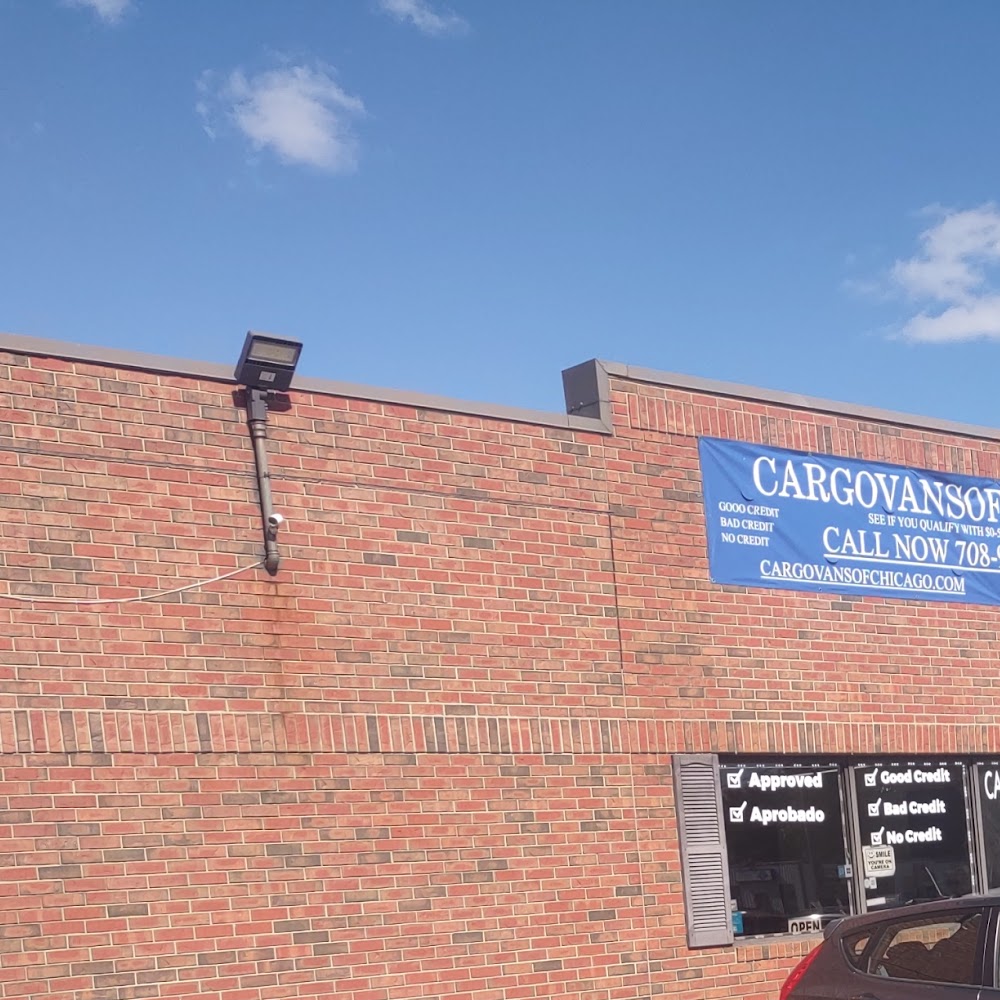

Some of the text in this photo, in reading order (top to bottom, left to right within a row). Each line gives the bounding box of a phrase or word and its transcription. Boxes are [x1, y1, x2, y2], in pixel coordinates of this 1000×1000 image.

[747, 505, 779, 518] CREDIT
[720, 517, 774, 532] BAD CREDIT
[868, 512, 886, 525] SEE
[887, 515, 896, 526] IF
[898, 516, 918, 529] YOU
[919, 519, 960, 534] QUALIFY
[960, 523, 983, 537] WITH
[721, 532, 770, 547] NO CREDIT
[823, 526, 889, 558] CALL
[892, 533, 949, 563] NOW
[760, 559, 966, 592] CARGOVANSOFCHICAGO.COM
[748, 772, 823, 791] Approved
[880, 767, 951, 784] Good Credit
[750, 806, 825, 826] Aprobado
[883, 798, 946, 816] Bad Credit
[886, 826, 942, 845] No Credit
[875, 850, 891, 858] SMILE
[790, 920, 820, 933] OPEN
